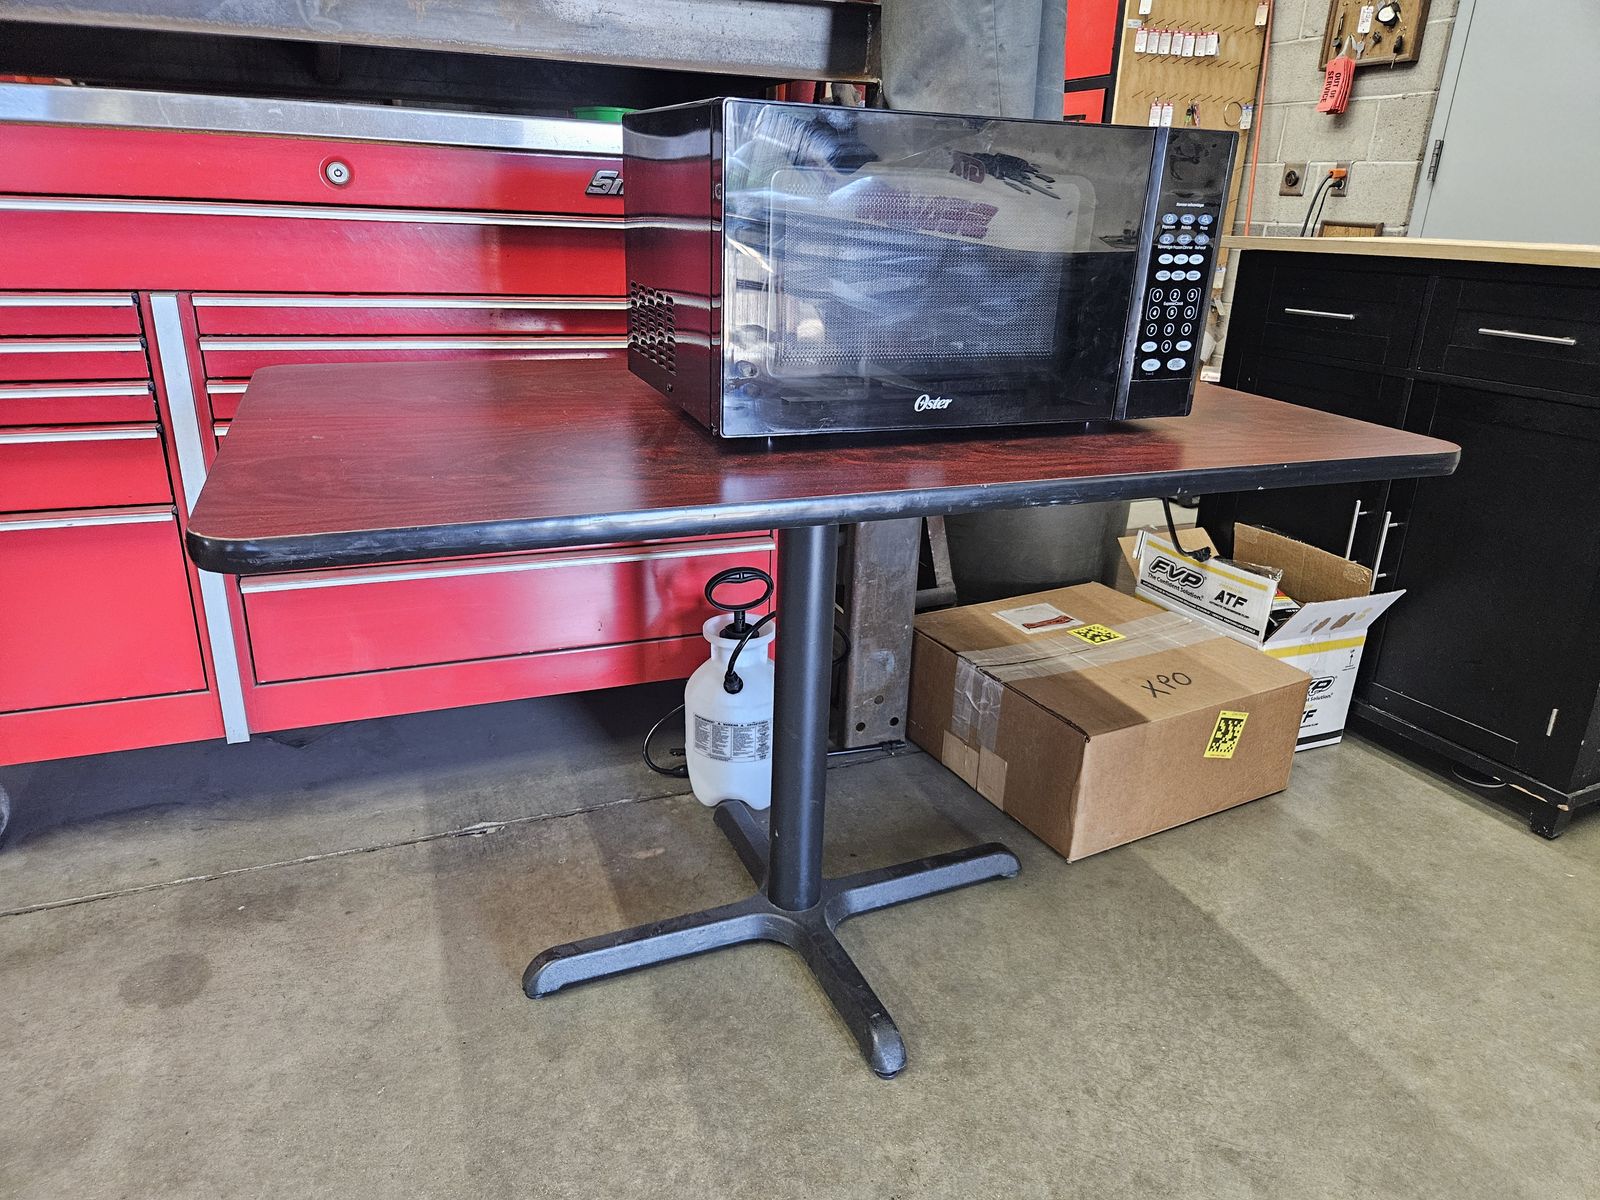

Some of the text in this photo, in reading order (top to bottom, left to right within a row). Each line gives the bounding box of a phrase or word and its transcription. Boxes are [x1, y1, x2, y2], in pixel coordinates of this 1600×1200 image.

[1320, 70, 1335, 103] SERVICE
[1329, 72, 1341, 98] OUT OF
[914, 394, 953, 412] Oster
[1150, 557, 1204, 588] FVP
[1214, 590, 1248, 608] ATF
[1140, 672, 1192, 699] XPO
